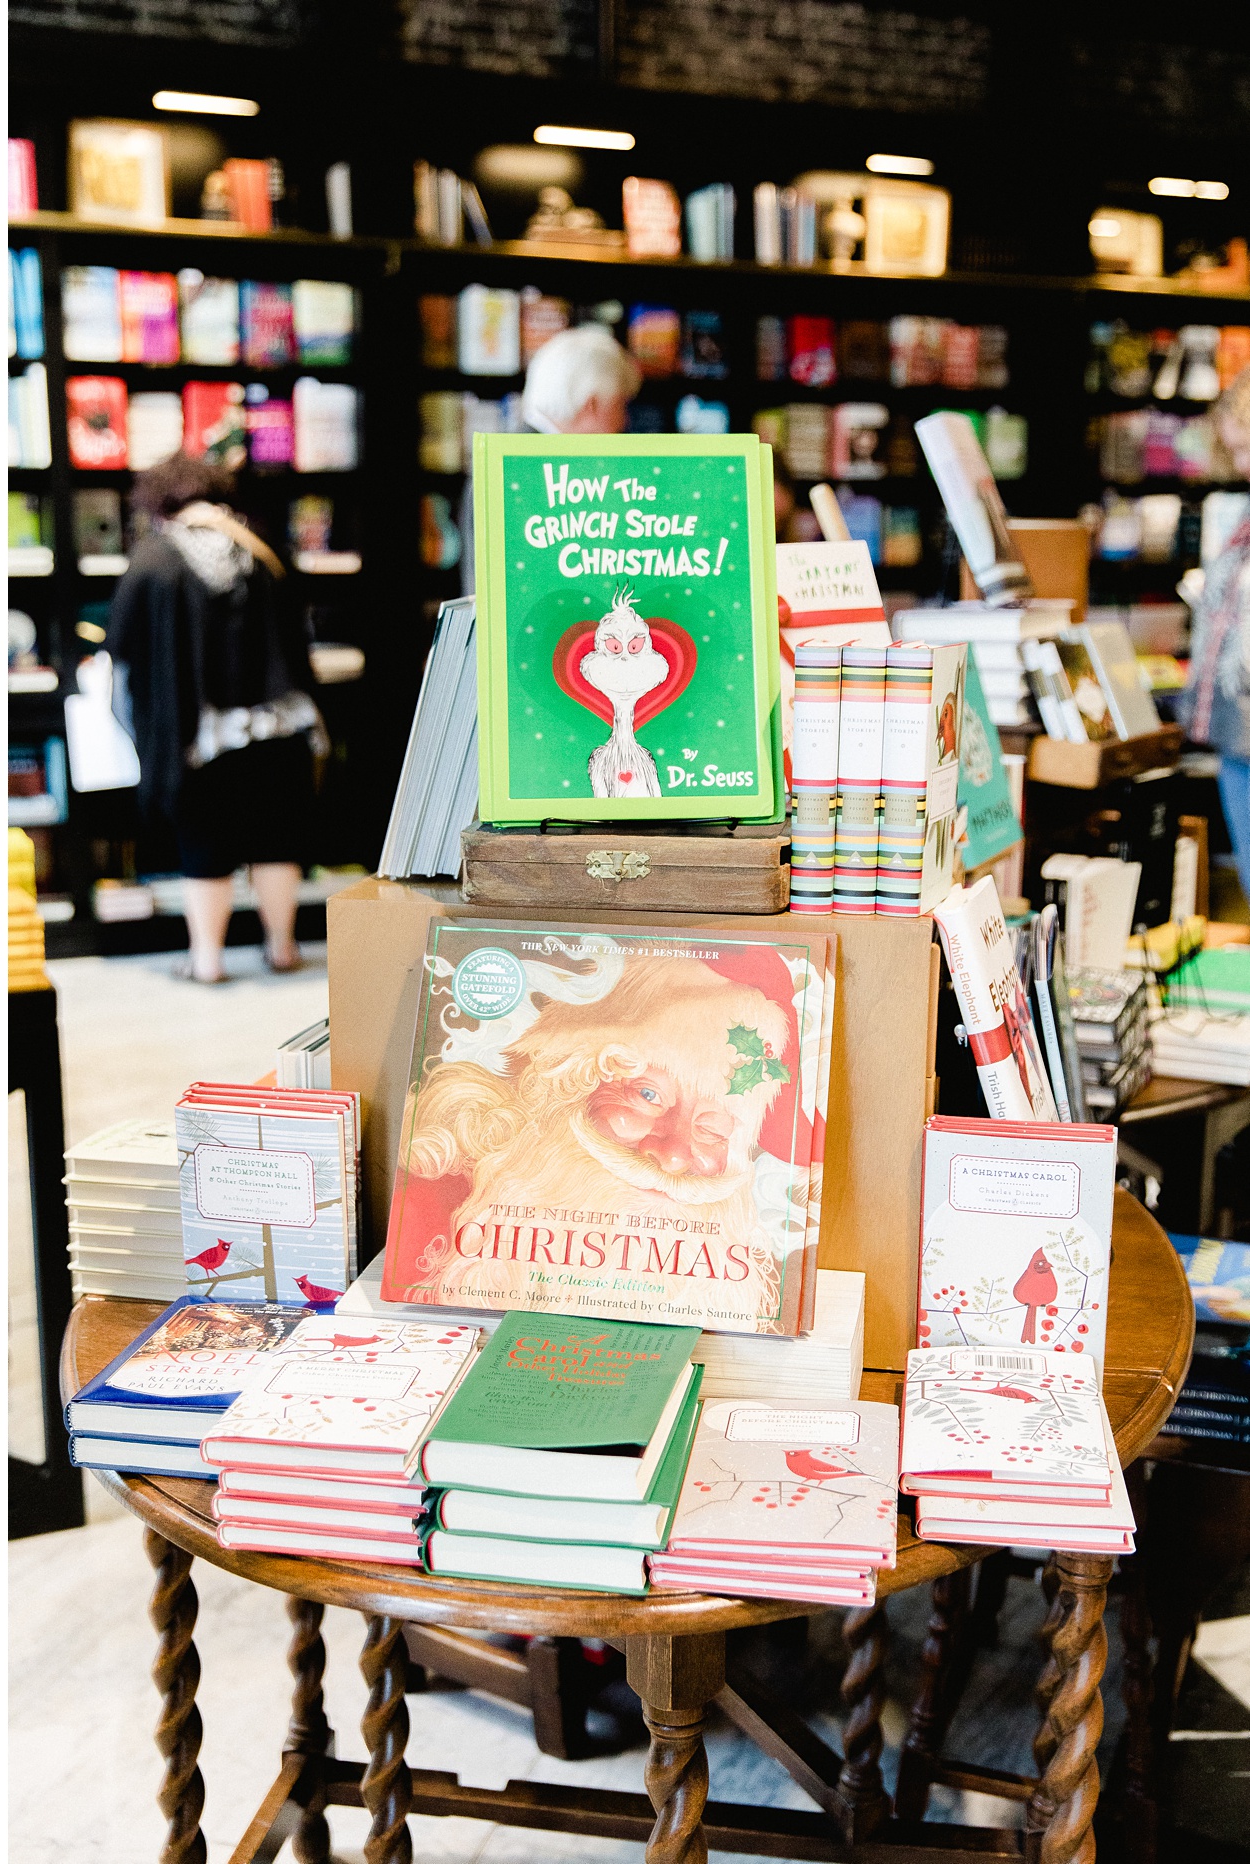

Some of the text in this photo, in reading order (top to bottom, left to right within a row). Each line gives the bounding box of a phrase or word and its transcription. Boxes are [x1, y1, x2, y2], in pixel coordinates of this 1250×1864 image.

[614, 477, 657, 502] The
[524, 509, 698, 549] GRINCH STOLE
[557, 537, 729, 578] CHRISTMAS!
[667, 763, 754, 789] Dr. Seuss
[979, 915, 1005, 949] White
[521, 941, 543, 952] THE
[570, 943, 599, 954] YORK
[602, 945, 634, 956] TIMES
[637, 946, 650, 957] #1
[652, 948, 720, 960] BESTSELLER
[467, 955, 510, 970] FEATURING
[461, 974, 517, 984] STUNNING
[461, 983, 516, 994] GATEFOLD
[949, 933, 982, 1026] White Elephant
[462, 993, 479, 1010] OVER
[492, 996, 512, 1012] WIDE
[987, 1071, 1001, 1100] Trish
[210, 1165, 298, 1180] AT THOMPSON HALL
[227, 1158, 280, 1169] CHRISTMAS
[216, 1177, 237, 1185] Other
[238, 1179, 274, 1188] Christmas
[972, 1168, 1030, 1180] CHRISTMAS
[1032, 1172, 1068, 1182] CAROL
[978, 1186, 1050, 1198] Charles Dickens
[488, 1203, 721, 1236] THE NIGHT BEFORE
[454, 1221, 751, 1283] CHRISTMAS
[528, 1270, 666, 1295] The Classic Edition
[442, 1284, 752, 1322] by Clement C. Moore Illustrated by Charles Santore
[515, 1336, 662, 1361] Christmas
[508, 1348, 634, 1370] Carol and
[145, 1364, 246, 1377] STREET
[148, 1376, 219, 1385] RICHARD
[127, 1382, 226, 1392] PAUL EVANS
